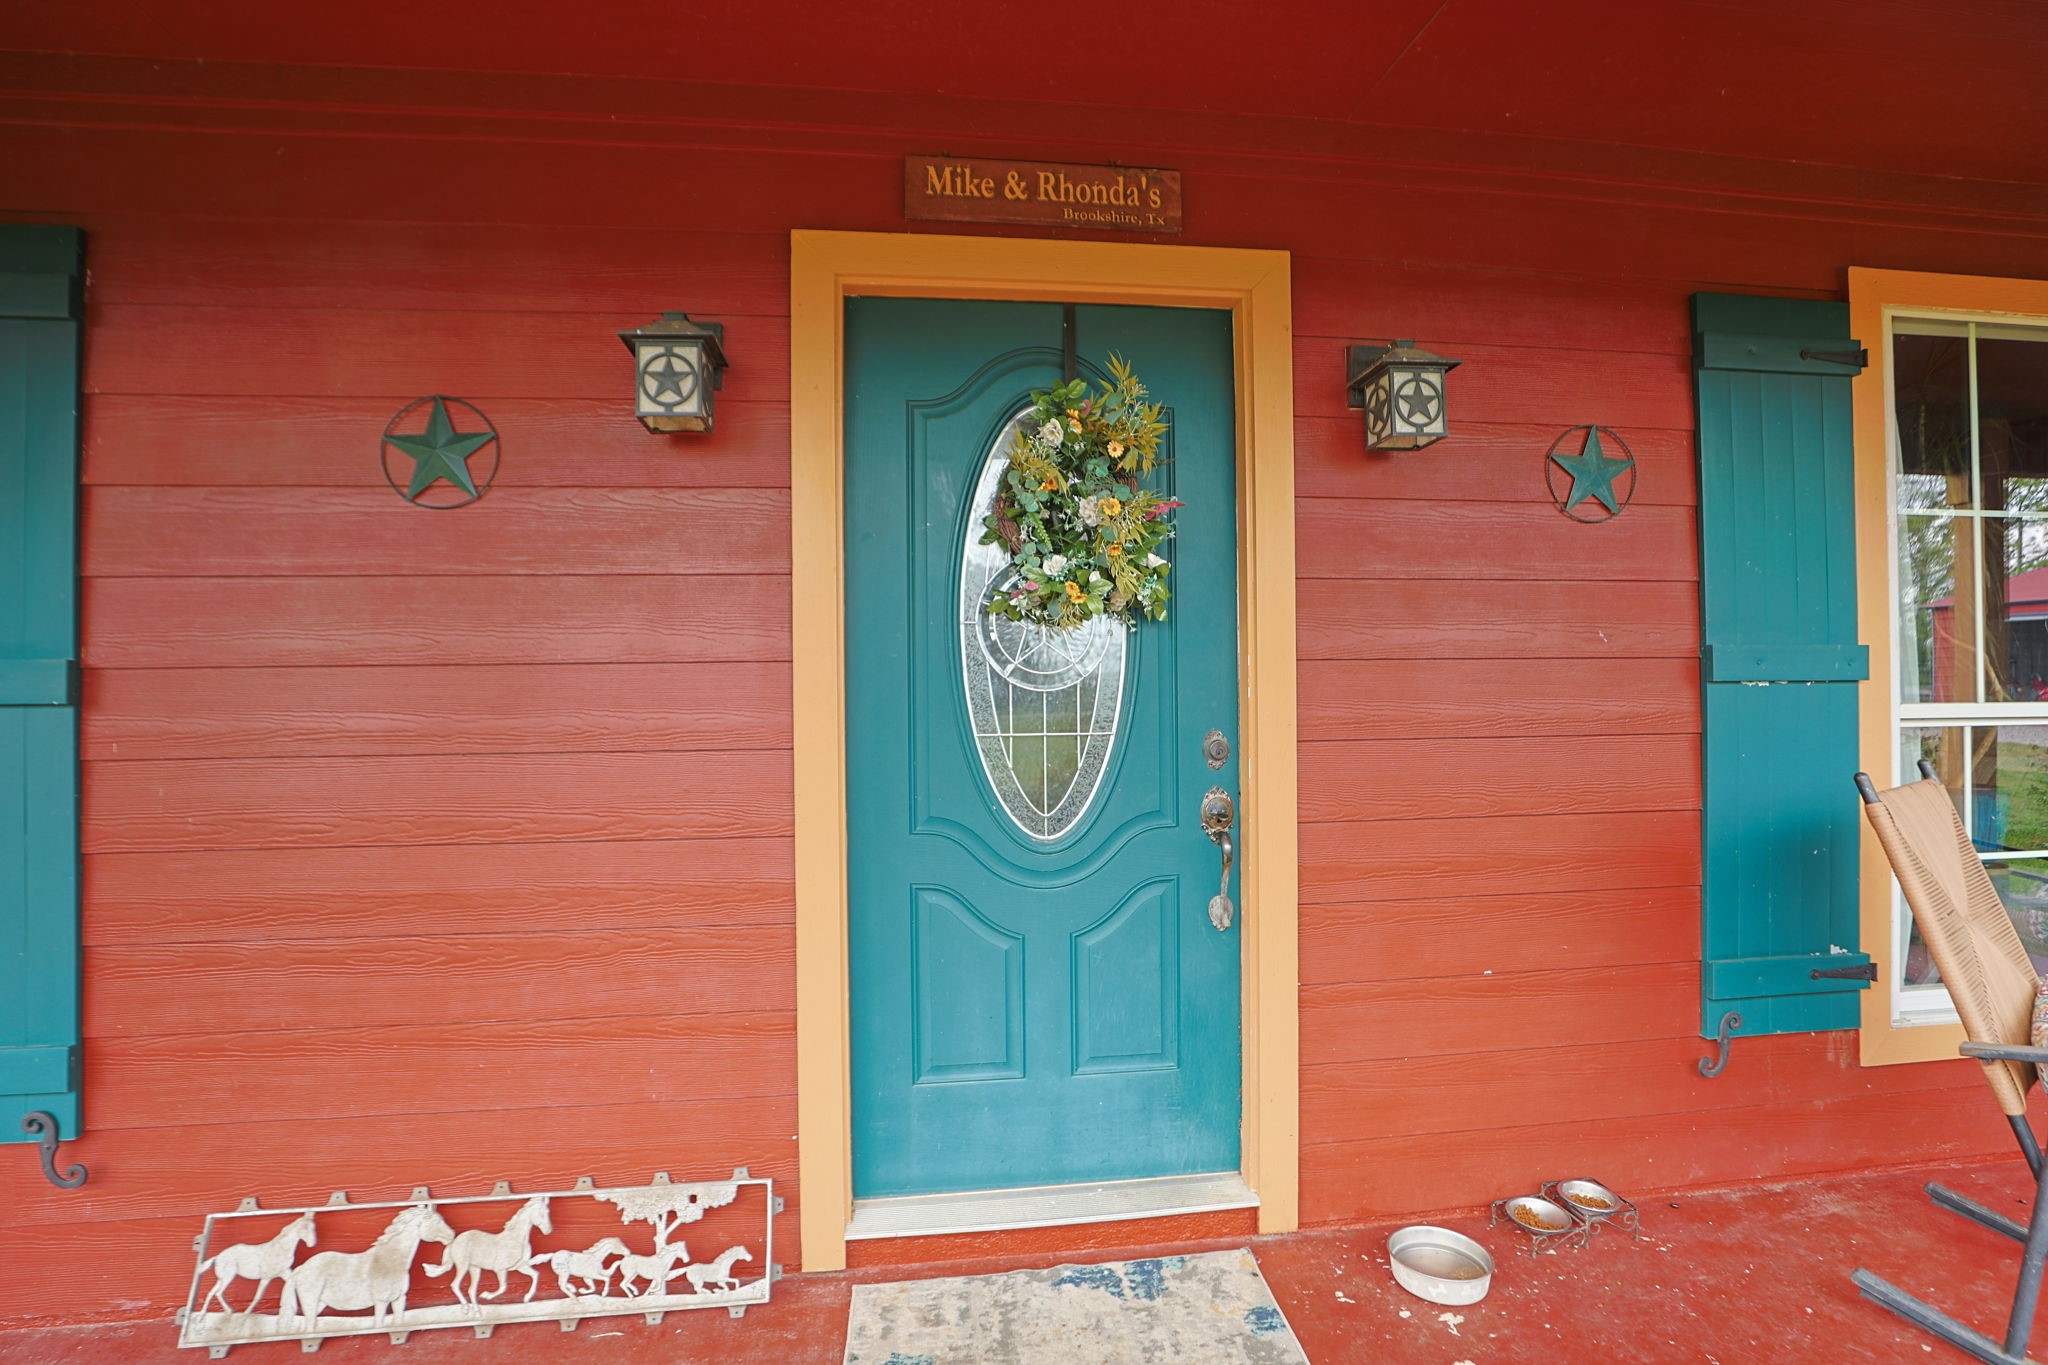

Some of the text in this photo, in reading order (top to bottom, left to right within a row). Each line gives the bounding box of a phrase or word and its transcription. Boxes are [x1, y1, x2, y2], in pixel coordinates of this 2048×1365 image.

[925, 165, 1161, 208] Mike & Rhonda's
[1063, 208, 1166, 226] Brookshire, Tx
